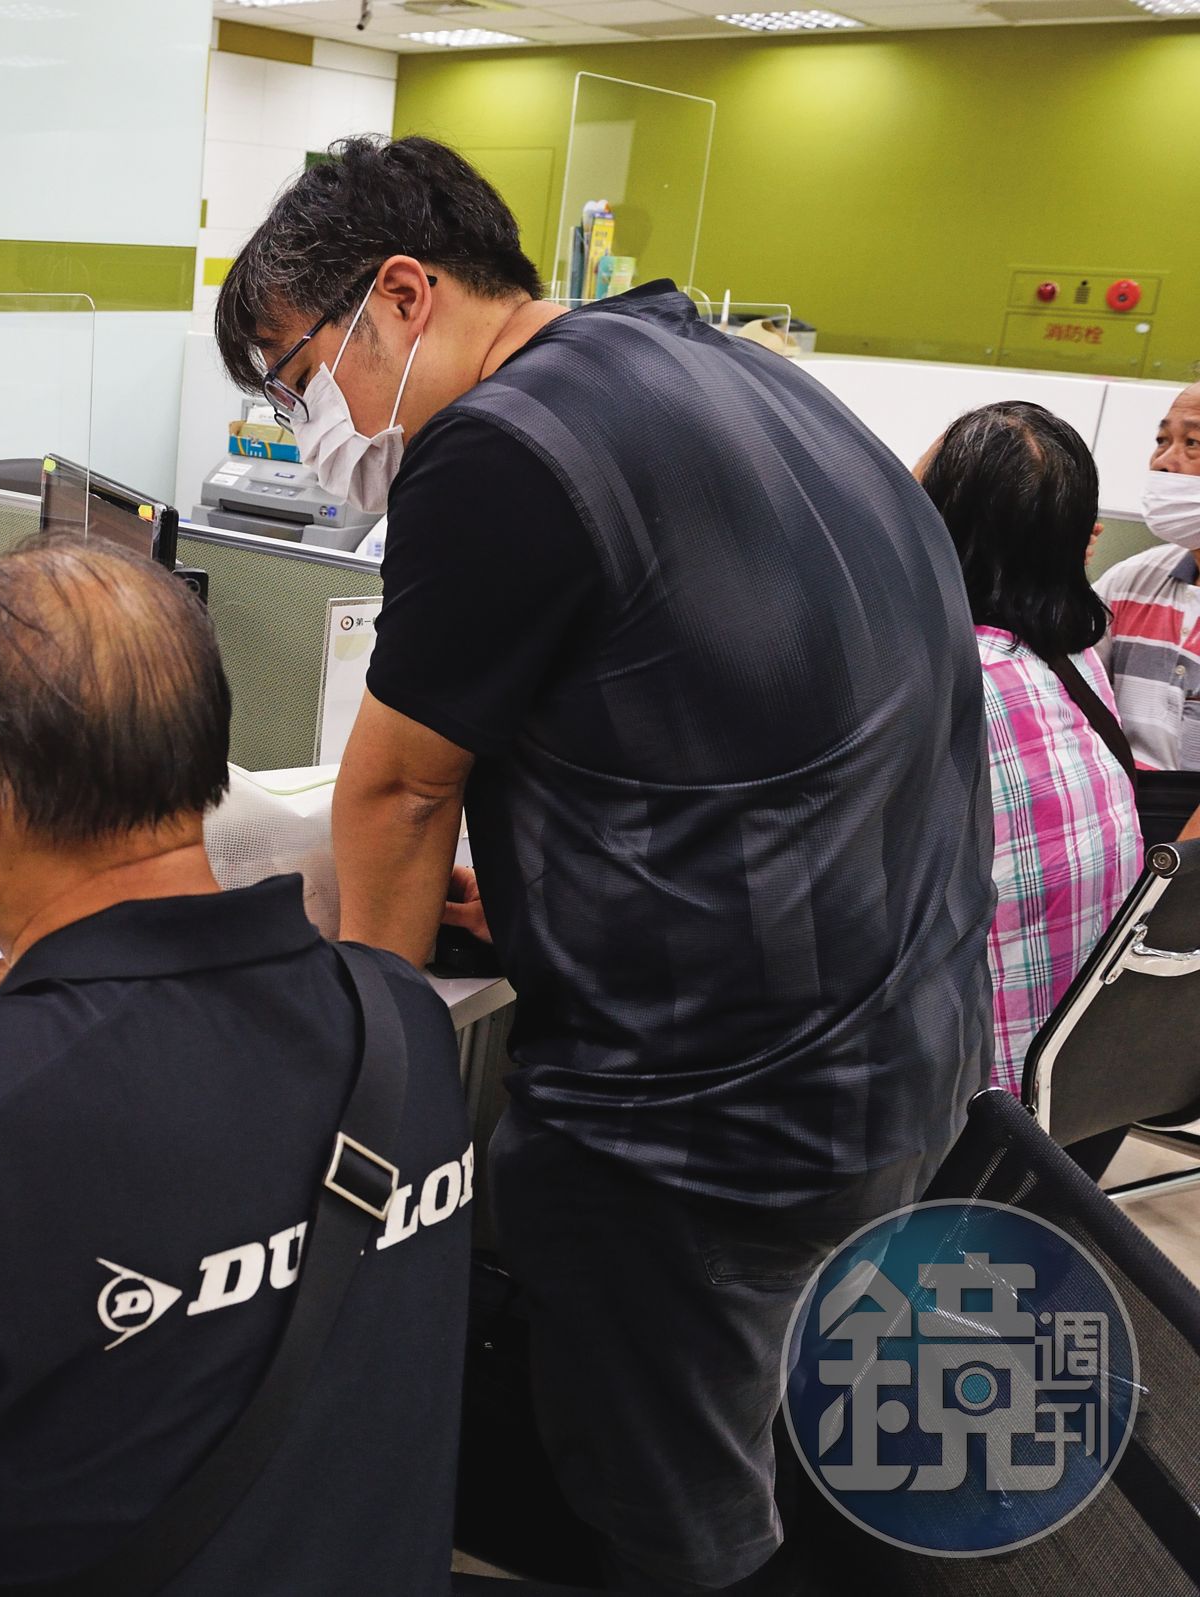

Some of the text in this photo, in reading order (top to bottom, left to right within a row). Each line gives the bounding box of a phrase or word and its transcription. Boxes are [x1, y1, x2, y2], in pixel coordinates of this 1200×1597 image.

[1044, 323, 1104, 344] 消防栓
[355, 616, 376, 627] 第一
[187, 1141, 474, 1316] DULOP
